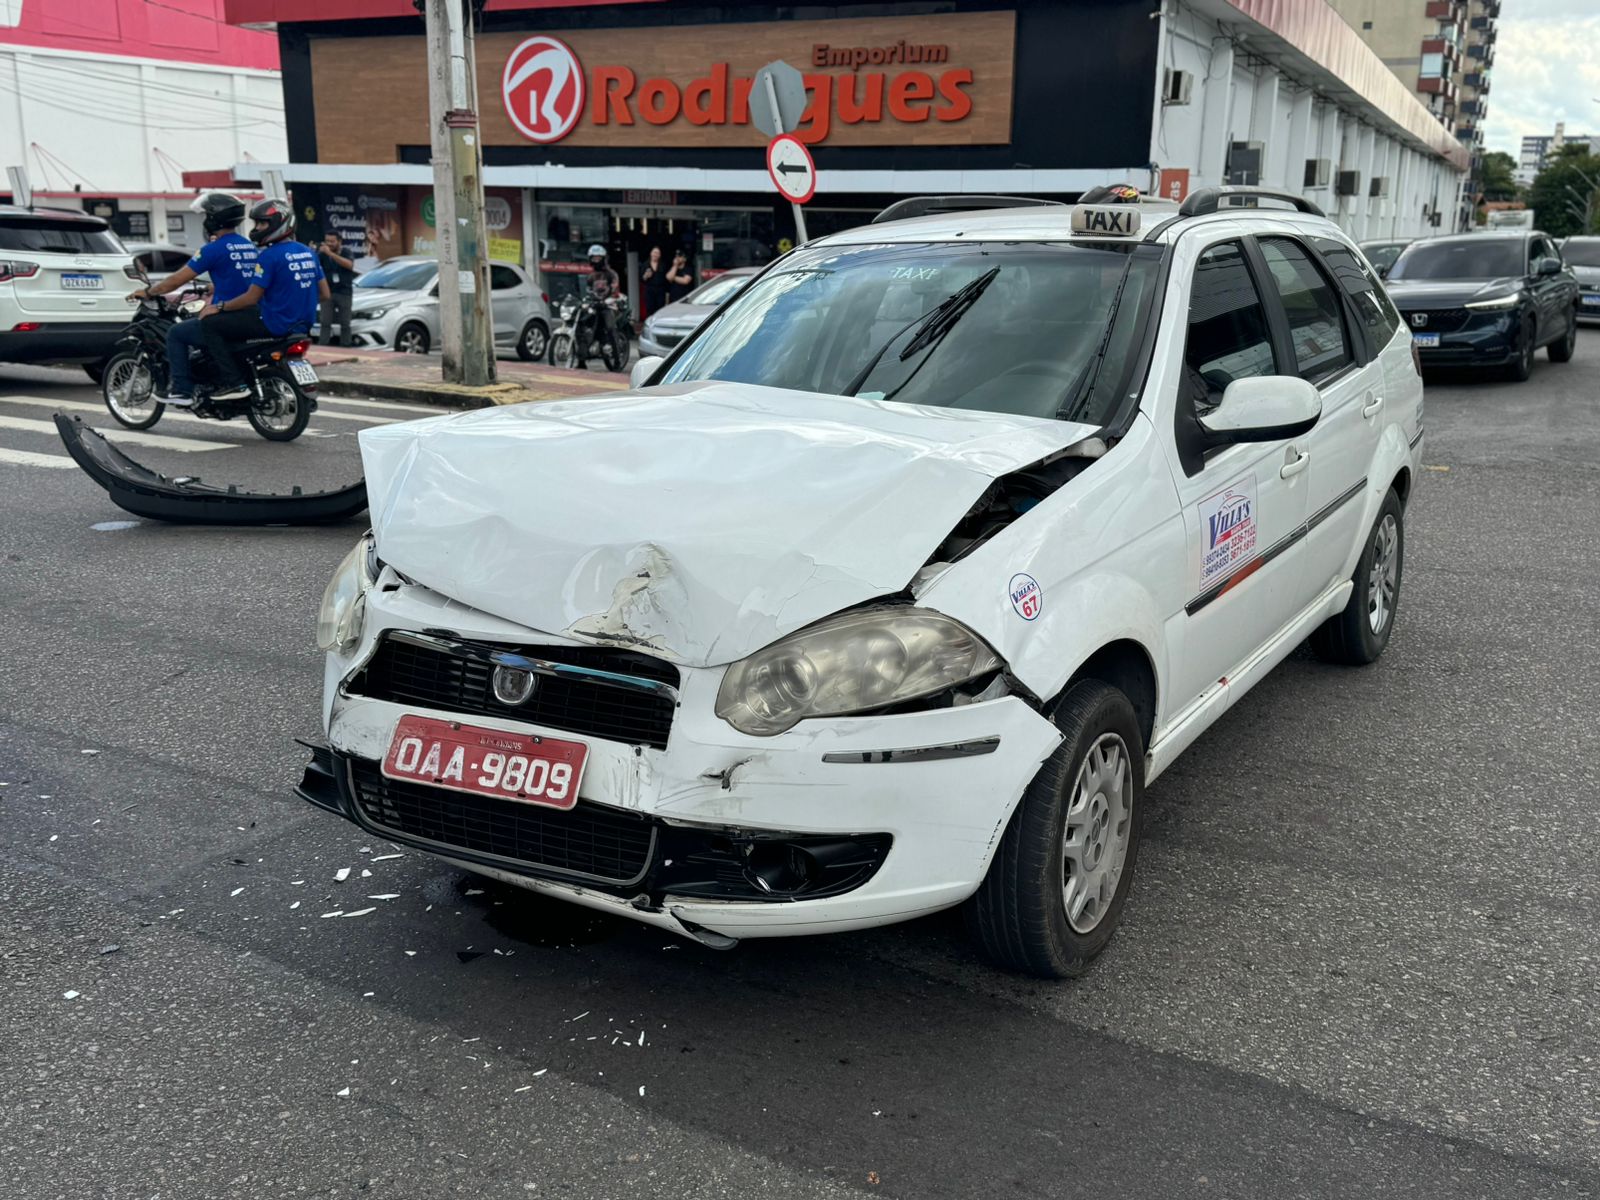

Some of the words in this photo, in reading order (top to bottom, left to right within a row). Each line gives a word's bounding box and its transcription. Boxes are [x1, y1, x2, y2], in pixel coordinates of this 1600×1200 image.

[812, 42, 948, 71] Emporium
[591, 62, 974, 145] Rodrgues
[629, 191, 671, 204] ENTRADA
[1083, 209, 1132, 233] TAXI
[891, 266, 939, 281] TAXI
[1022, 594, 1038, 618] 67
[395, 737, 573, 799] OAA-9809
